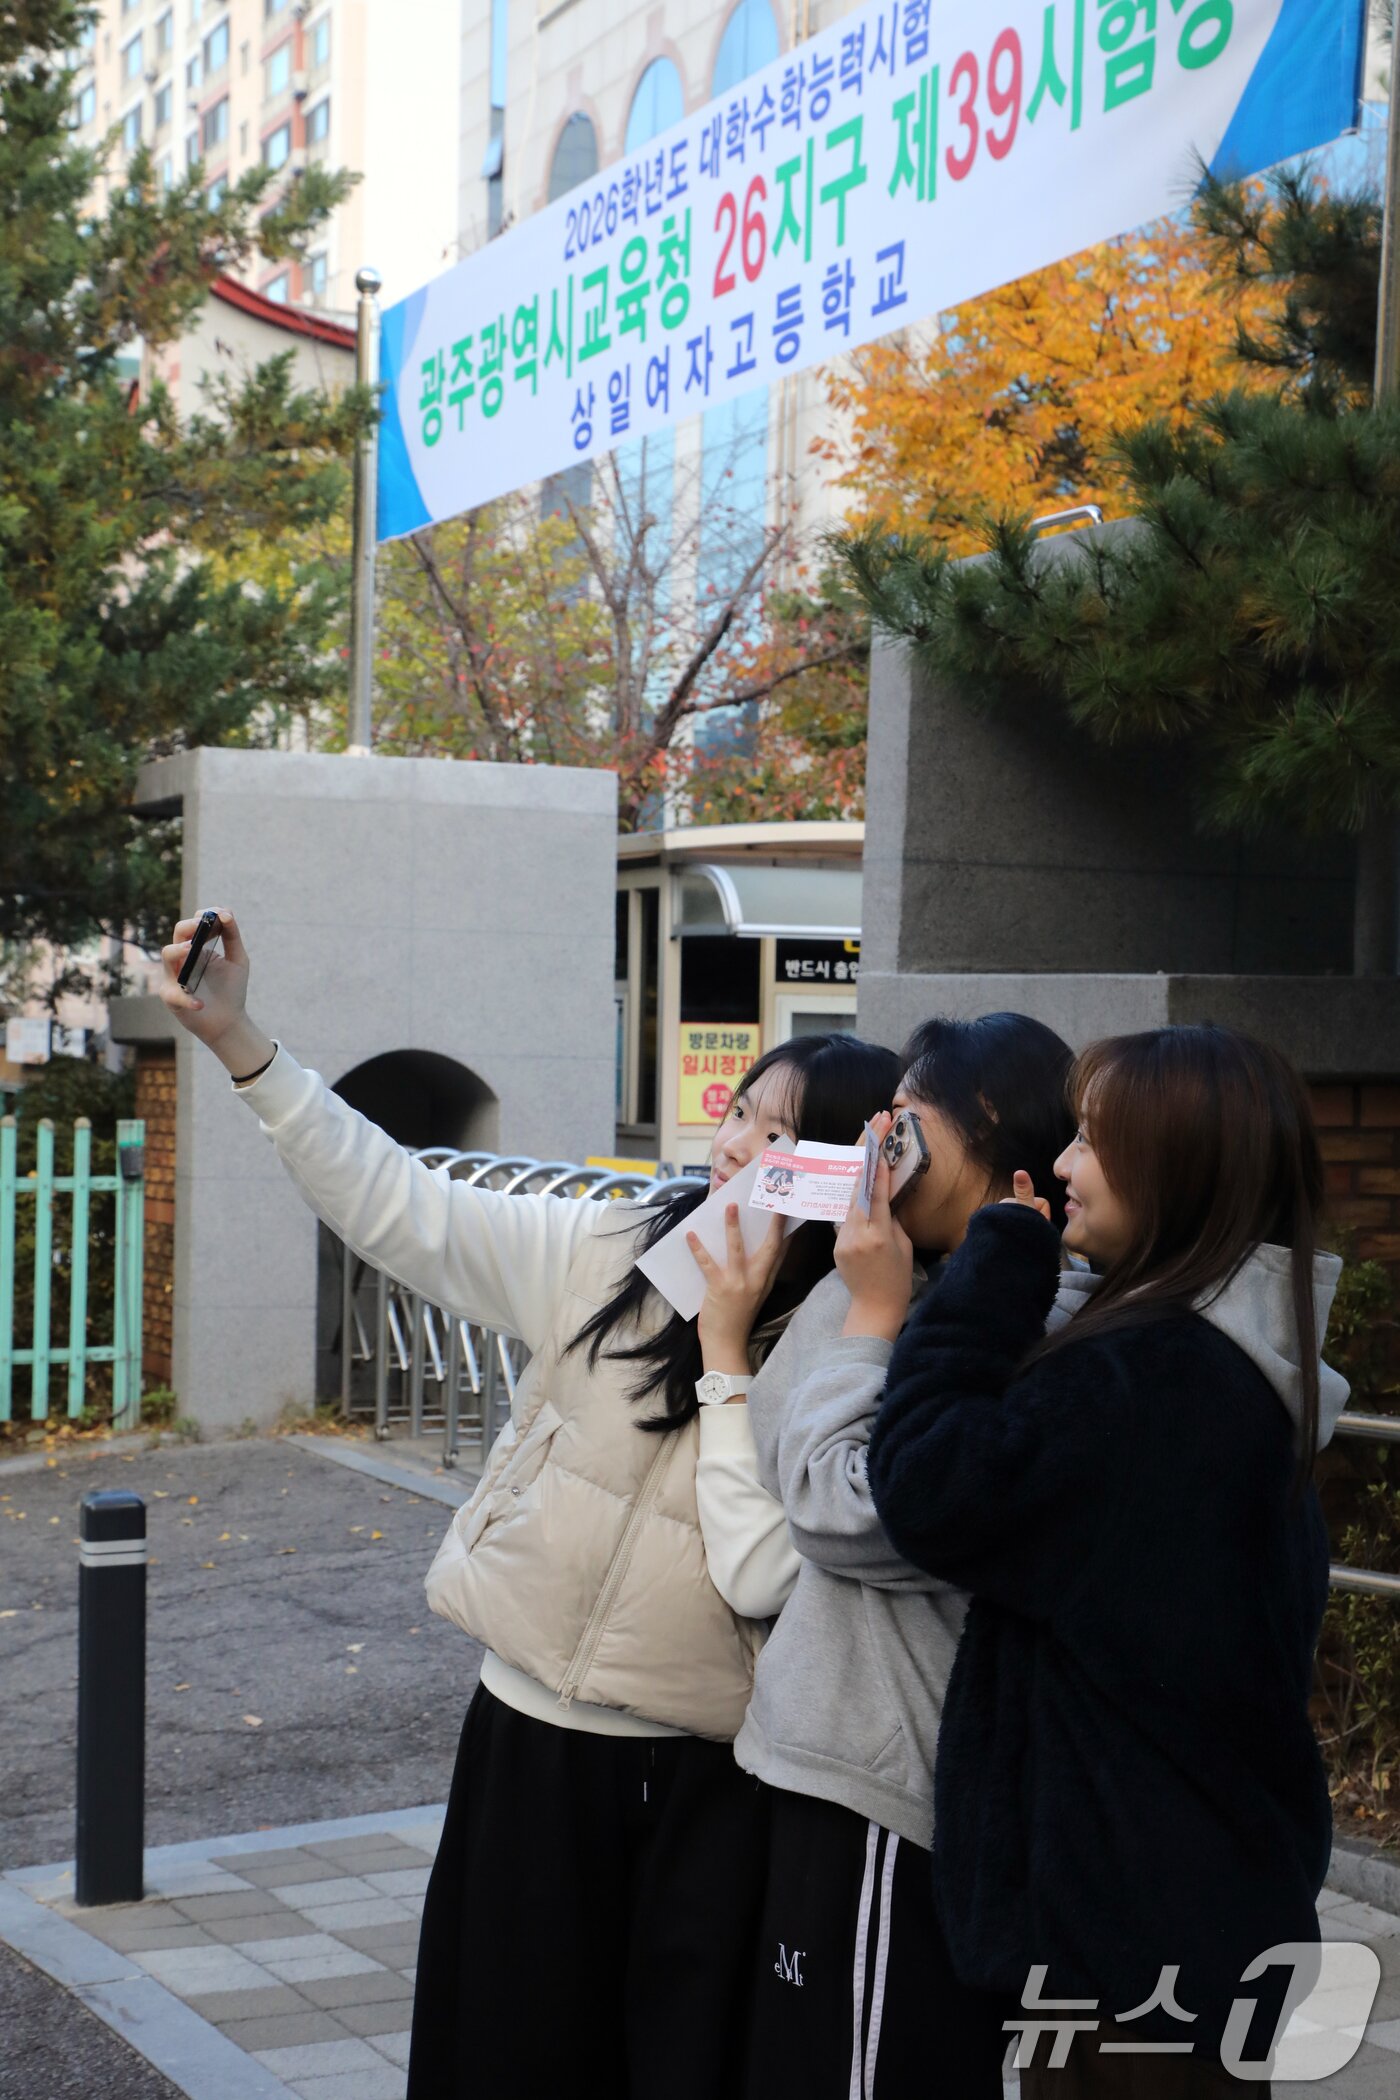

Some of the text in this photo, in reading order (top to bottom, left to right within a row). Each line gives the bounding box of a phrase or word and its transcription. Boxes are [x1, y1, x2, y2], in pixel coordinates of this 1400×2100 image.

[564, 0, 931, 261] 2026학년도 대학수학능력시험
[419, 207, 692, 449] 광주광역시교육청
[713, 114, 869, 300] 26지구
[785, 959, 830, 979] 반드시
[689, 1031, 750, 1050] 방문차량
[682, 1054, 755, 1076] 일시정지
